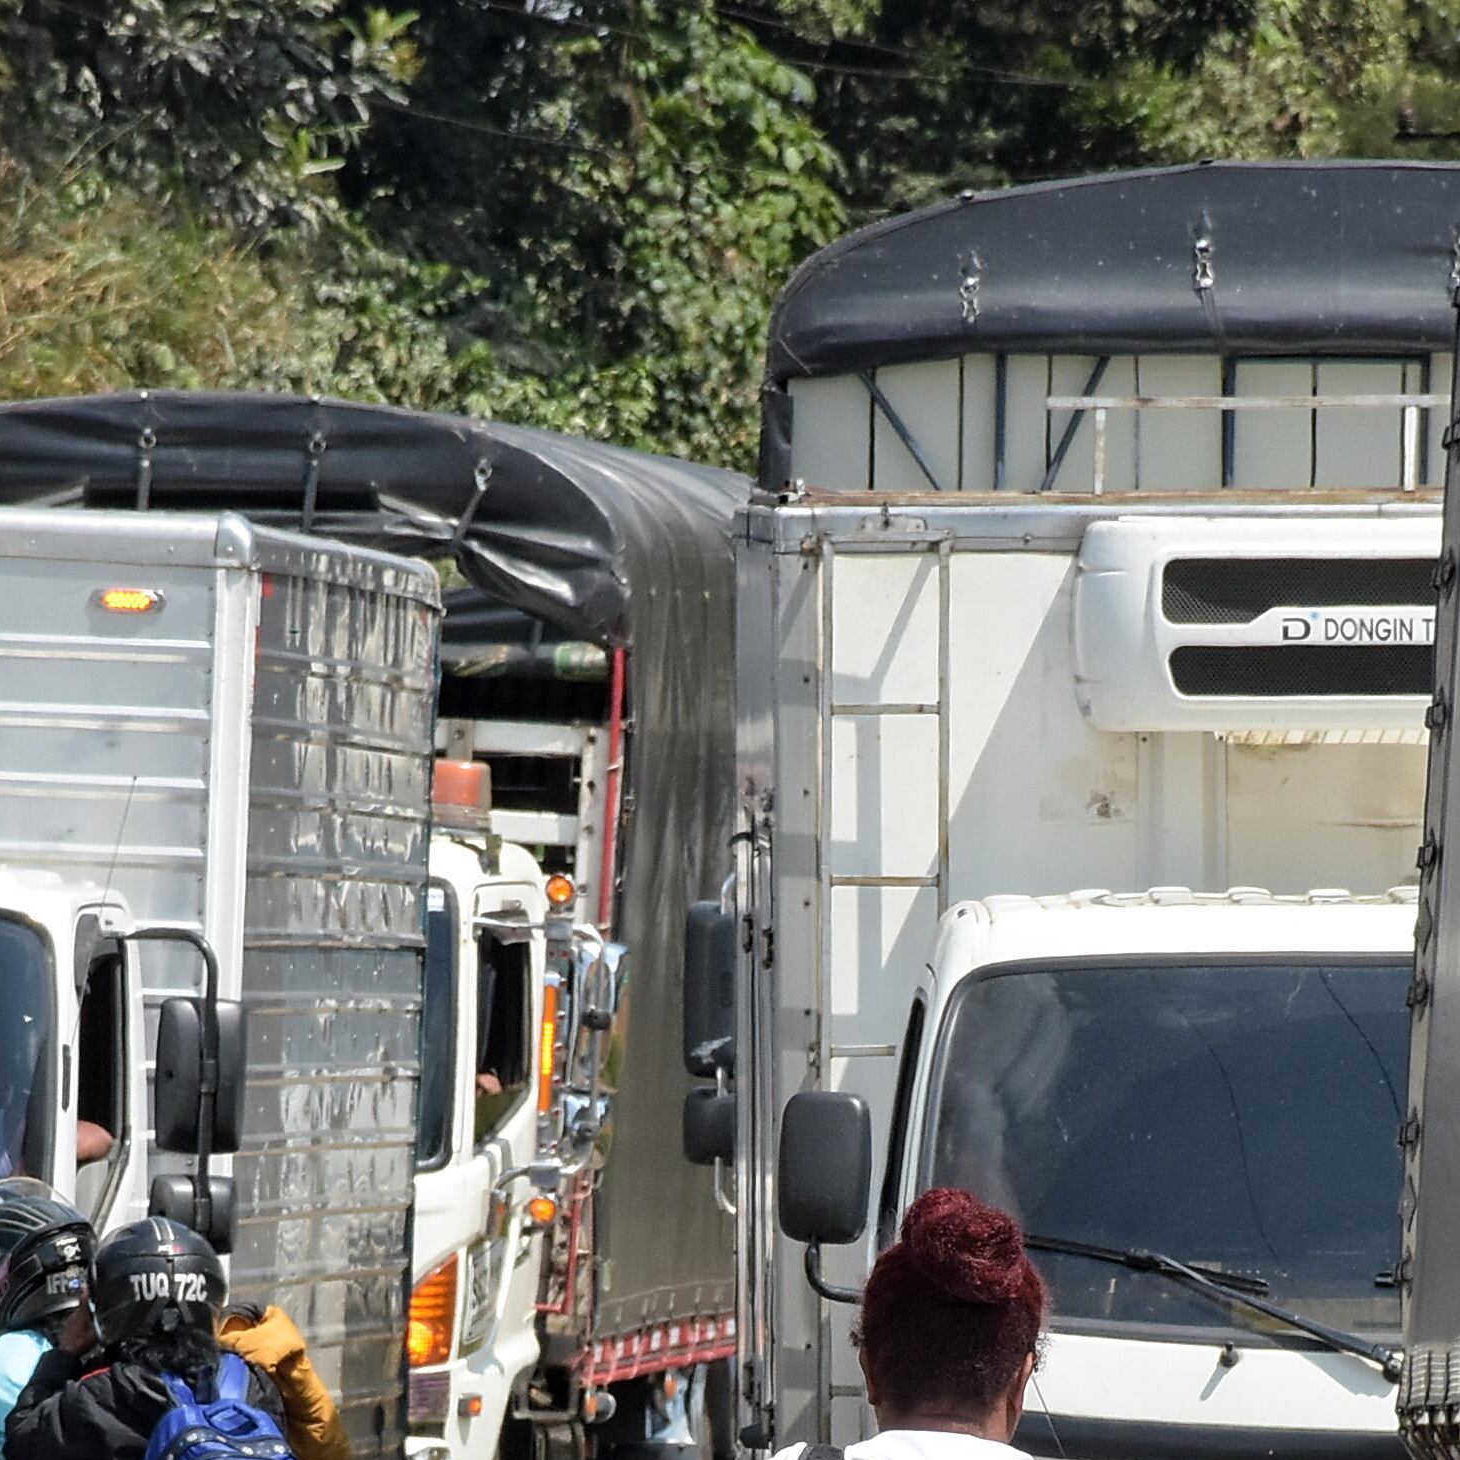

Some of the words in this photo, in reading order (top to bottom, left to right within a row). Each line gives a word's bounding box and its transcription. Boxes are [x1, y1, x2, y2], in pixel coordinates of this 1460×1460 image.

[1324, 617, 1413, 642] DONGIN
[130, 1272, 169, 1302] TUQ
[174, 1272, 208, 1302] 72C
